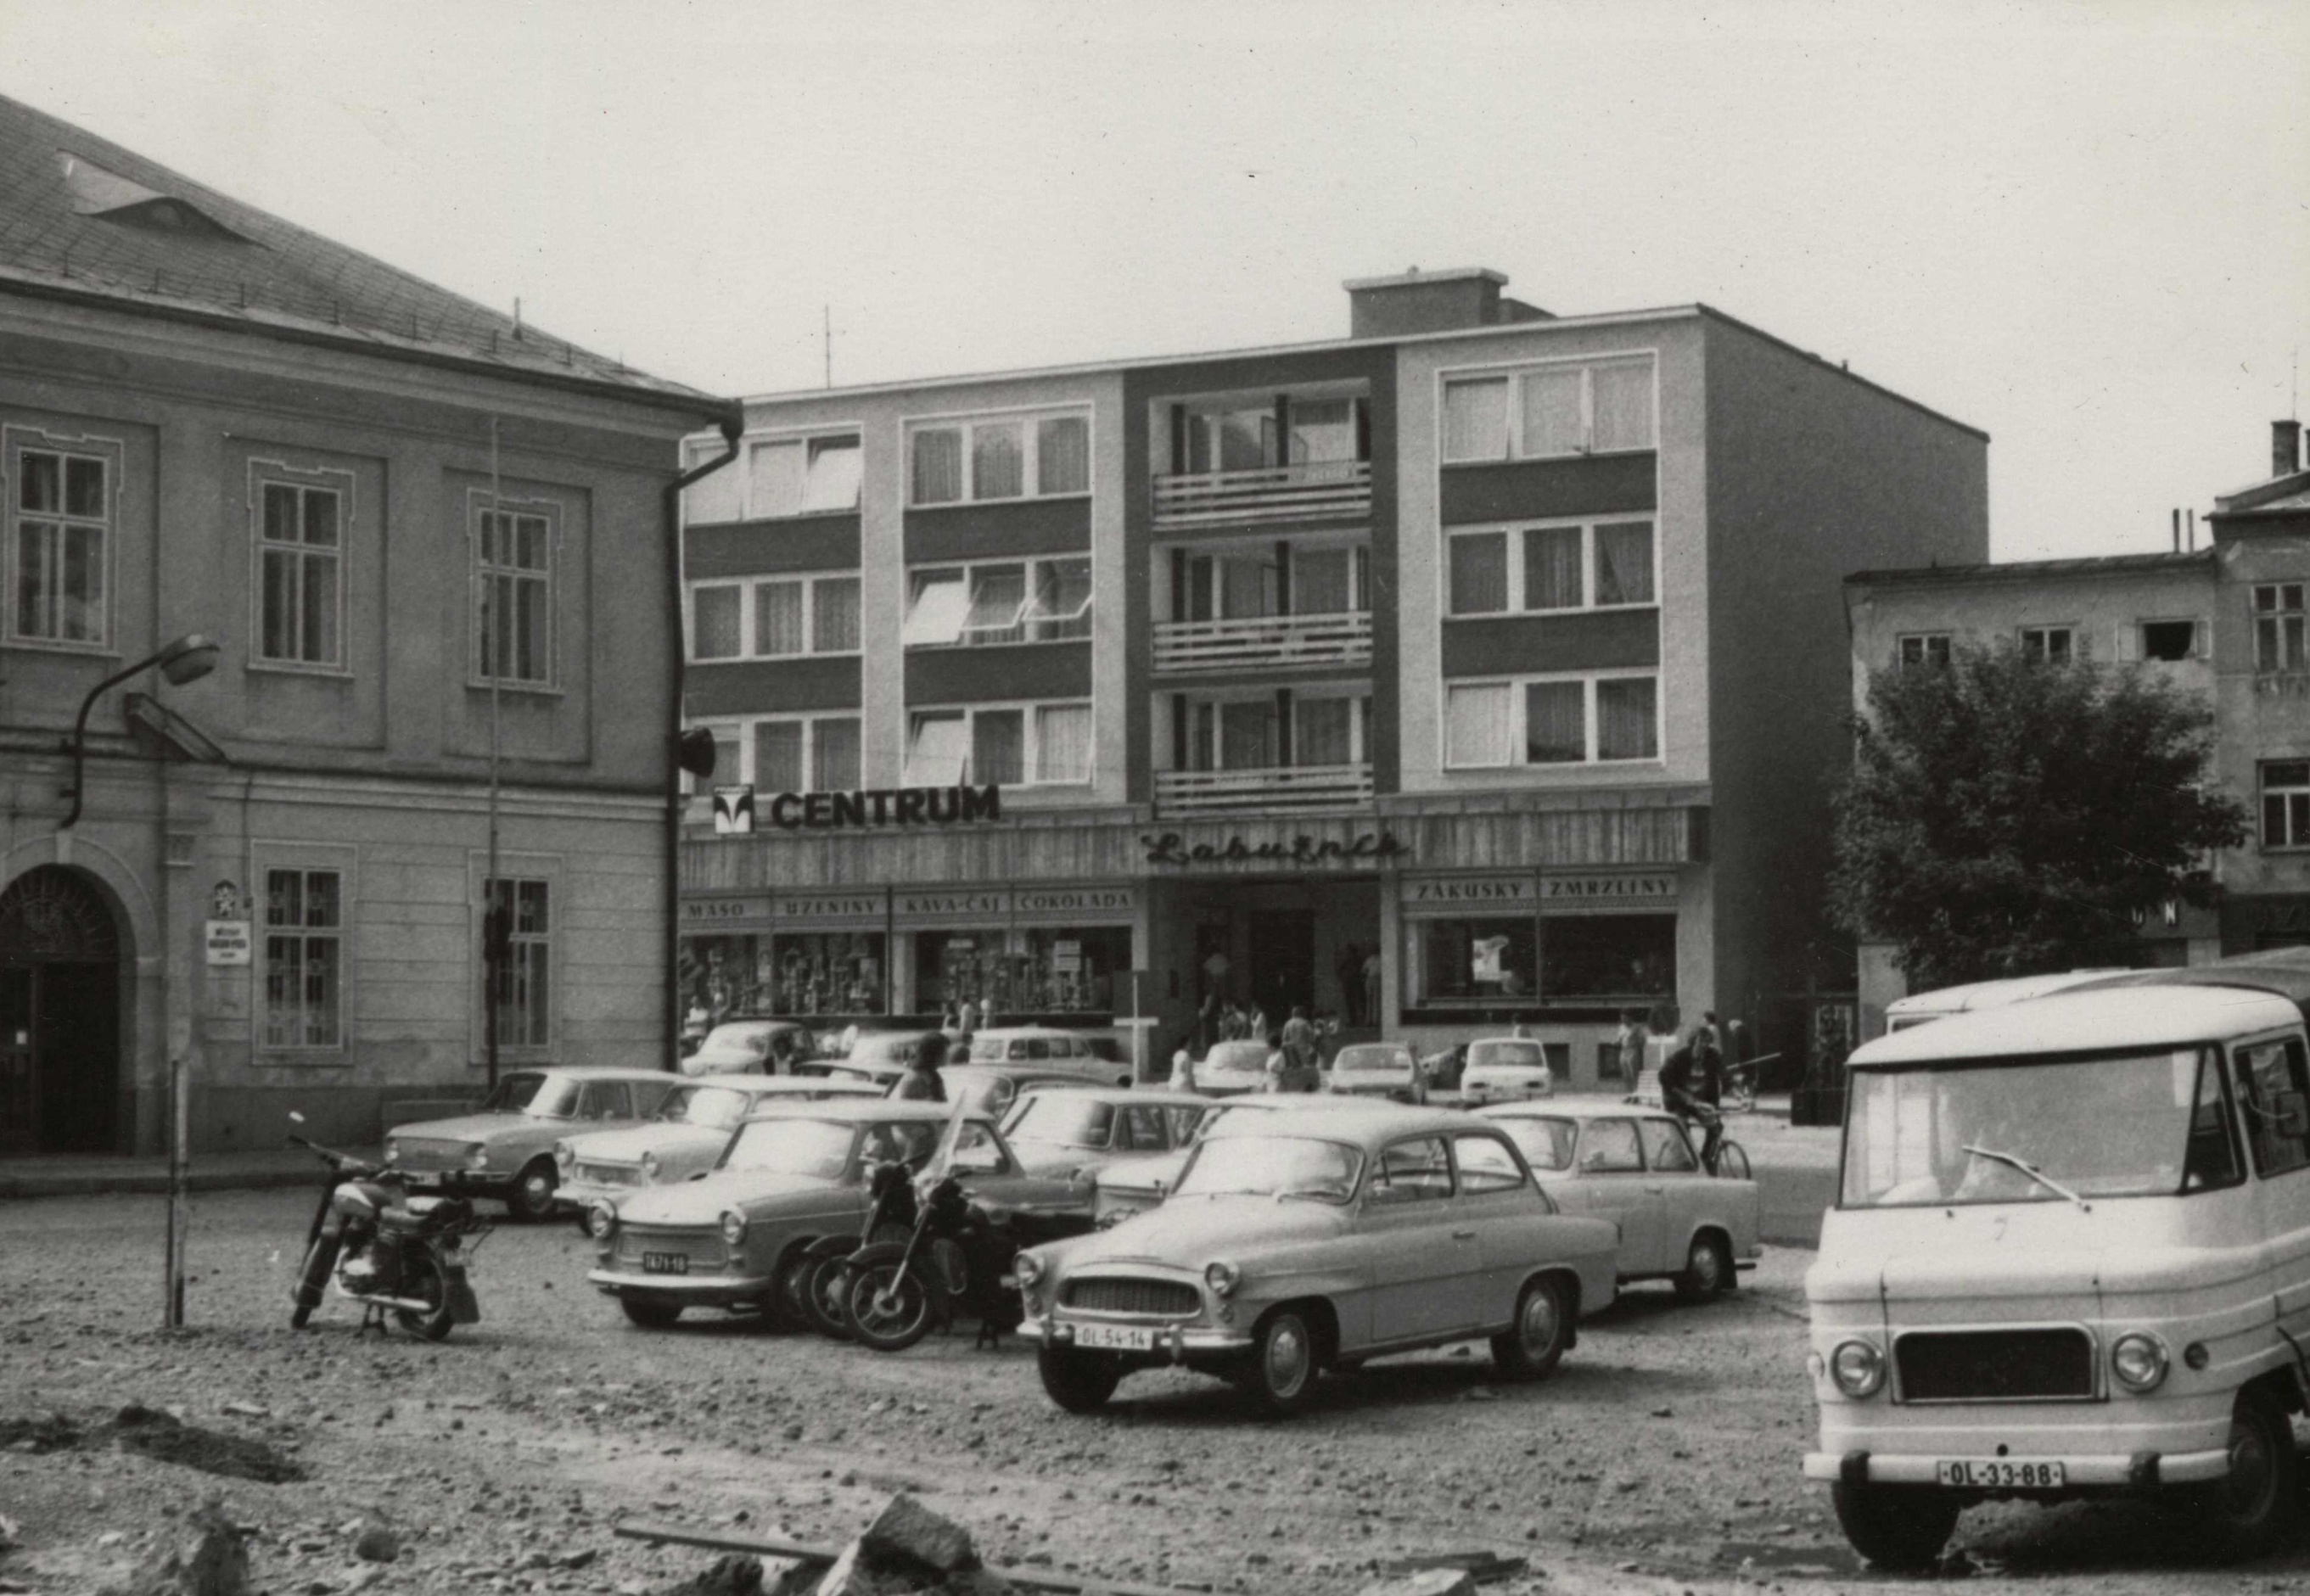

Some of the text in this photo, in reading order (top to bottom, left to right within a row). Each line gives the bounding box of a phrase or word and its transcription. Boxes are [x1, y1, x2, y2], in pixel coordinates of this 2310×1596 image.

[771, 784, 1001, 829] CENTRUM
[1416, 879, 1522, 899] ZÁKUSKY
[1550, 877, 1672, 896] ZMRZLINY
[689, 903, 744, 917] MASO
[785, 899, 875, 915] UZENINY
[1950, 1462, 2052, 1486] OL-33-88
